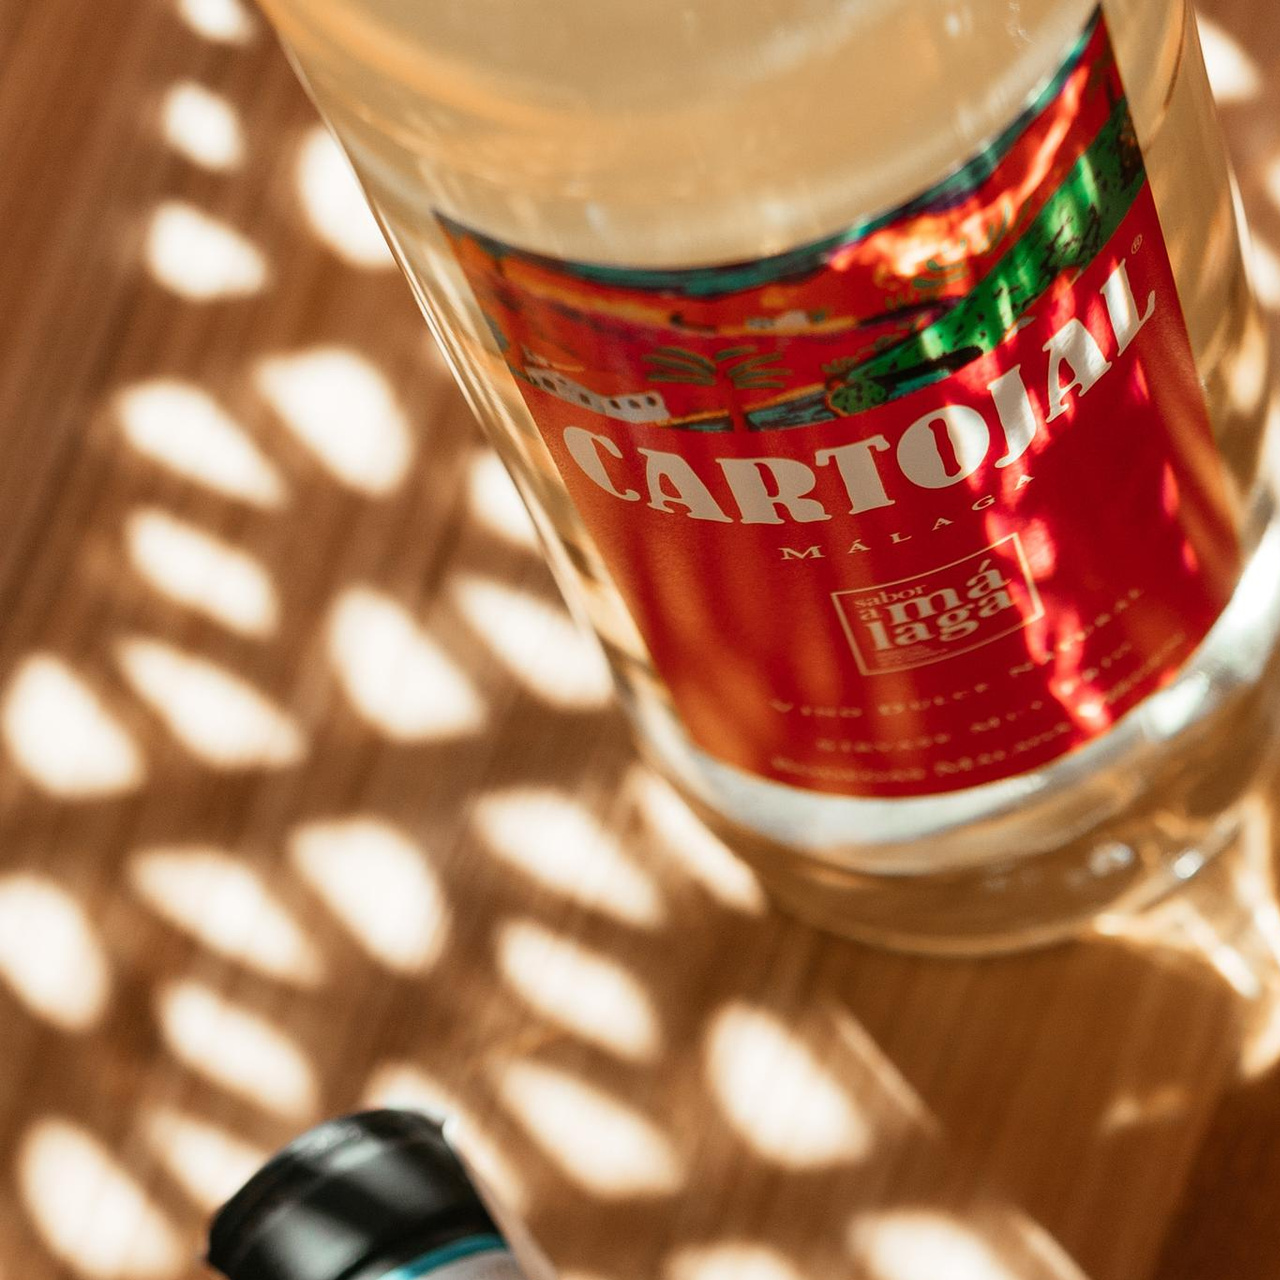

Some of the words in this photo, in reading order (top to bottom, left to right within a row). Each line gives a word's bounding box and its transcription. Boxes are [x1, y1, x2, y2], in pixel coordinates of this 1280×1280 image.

[562, 256, 1159, 526] CARTOJAL
[780, 473, 1036, 561] MÁLAGA
[854, 584, 927, 609] sabor
